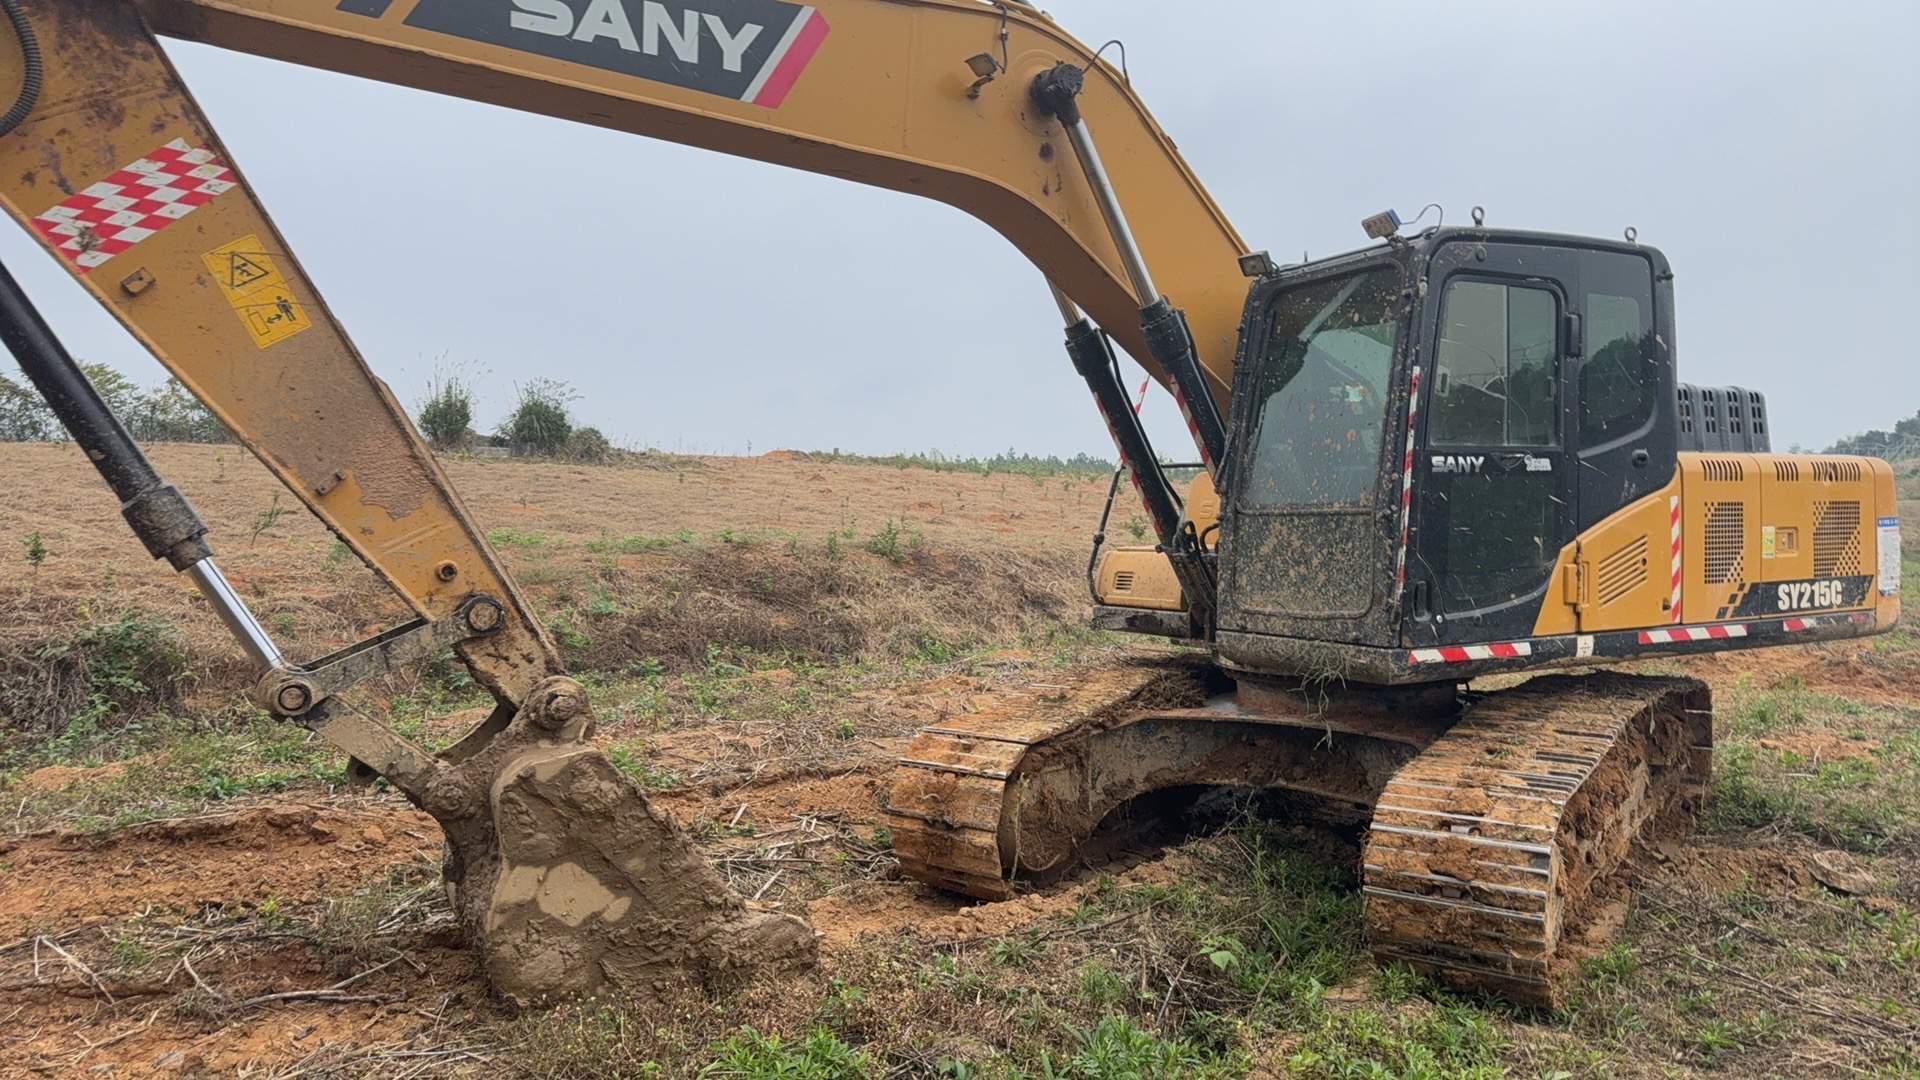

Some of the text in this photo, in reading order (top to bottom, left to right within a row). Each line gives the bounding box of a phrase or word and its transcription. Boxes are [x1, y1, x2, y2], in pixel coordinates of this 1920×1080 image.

[510, 0, 764, 72] SANY
[1431, 456, 1485, 473] SANY
[1777, 580, 1842, 610] SY215C
